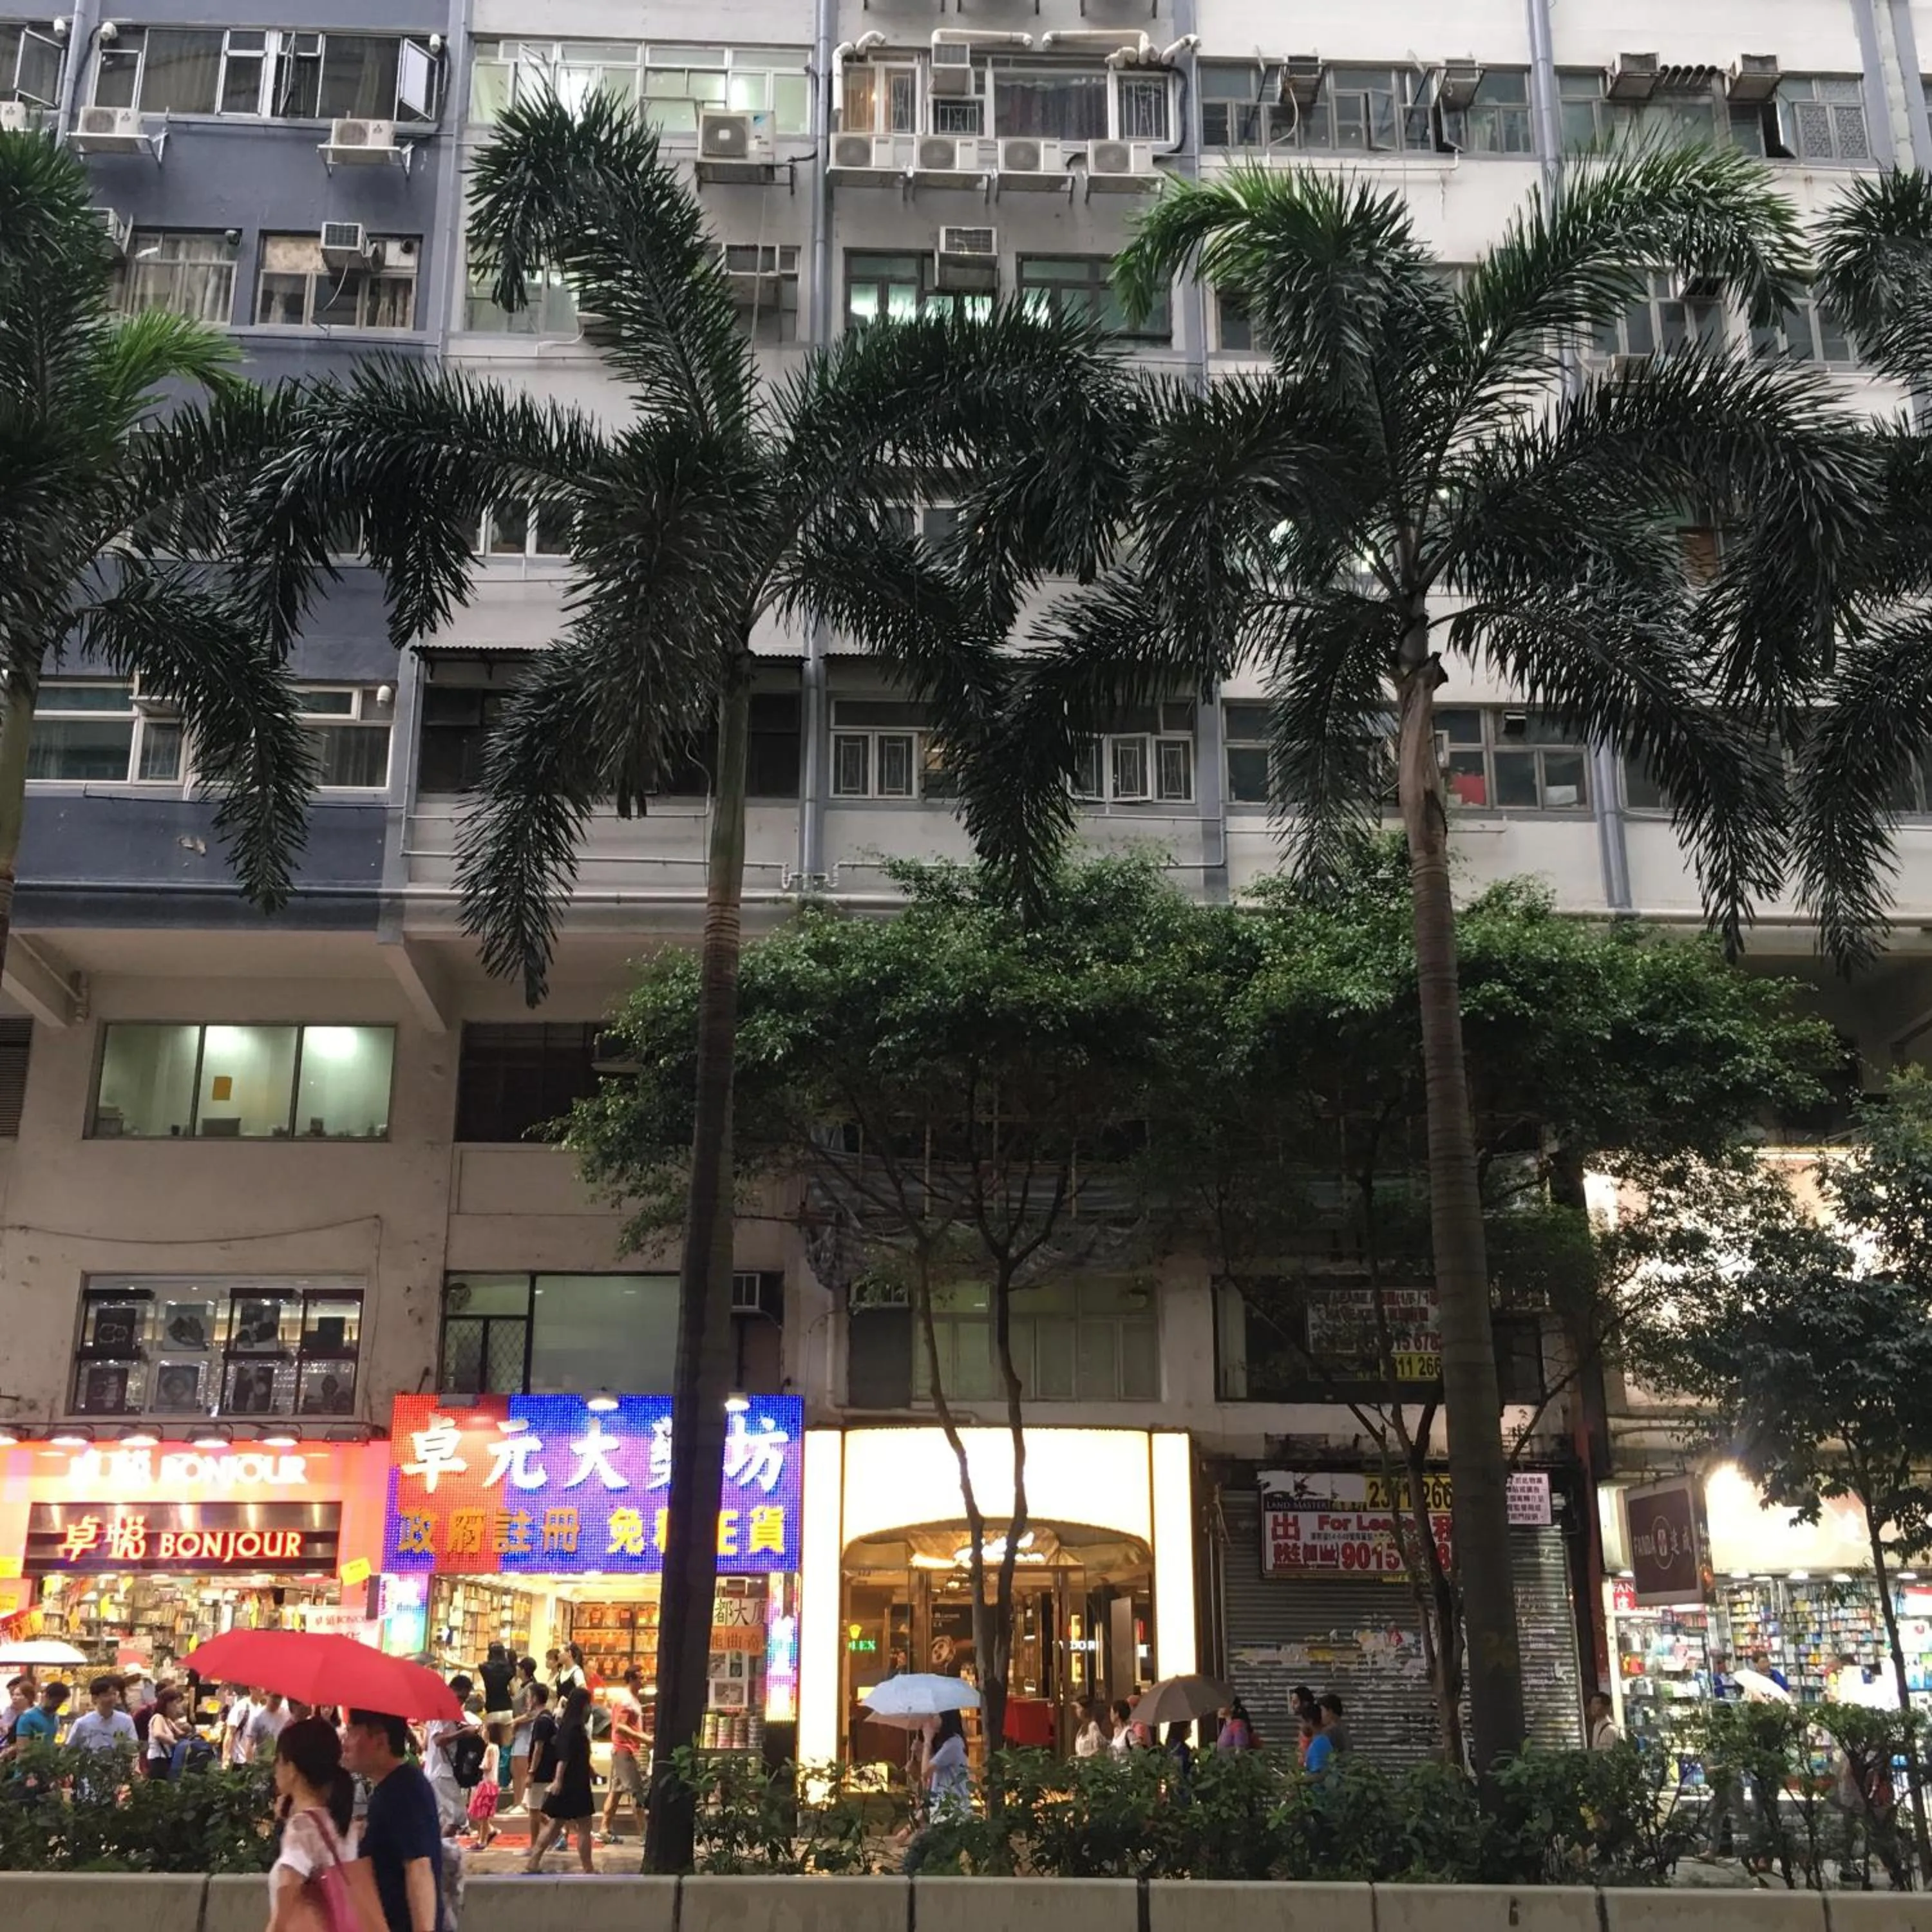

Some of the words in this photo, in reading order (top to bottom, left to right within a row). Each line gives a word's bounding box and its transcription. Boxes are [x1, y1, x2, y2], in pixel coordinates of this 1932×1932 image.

[160, 1454, 307, 1484] BONJOUR
[399, 1506, 582, 1553] 政府註冊
[1271, 1513, 1300, 1541] 出
[1318, 1515, 1352, 1531] For
[1356, 1515, 1416, 1532] Leae
[160, 1531, 302, 1563] BONJOUR
[1341, 1542, 1401, 1570] 9015
